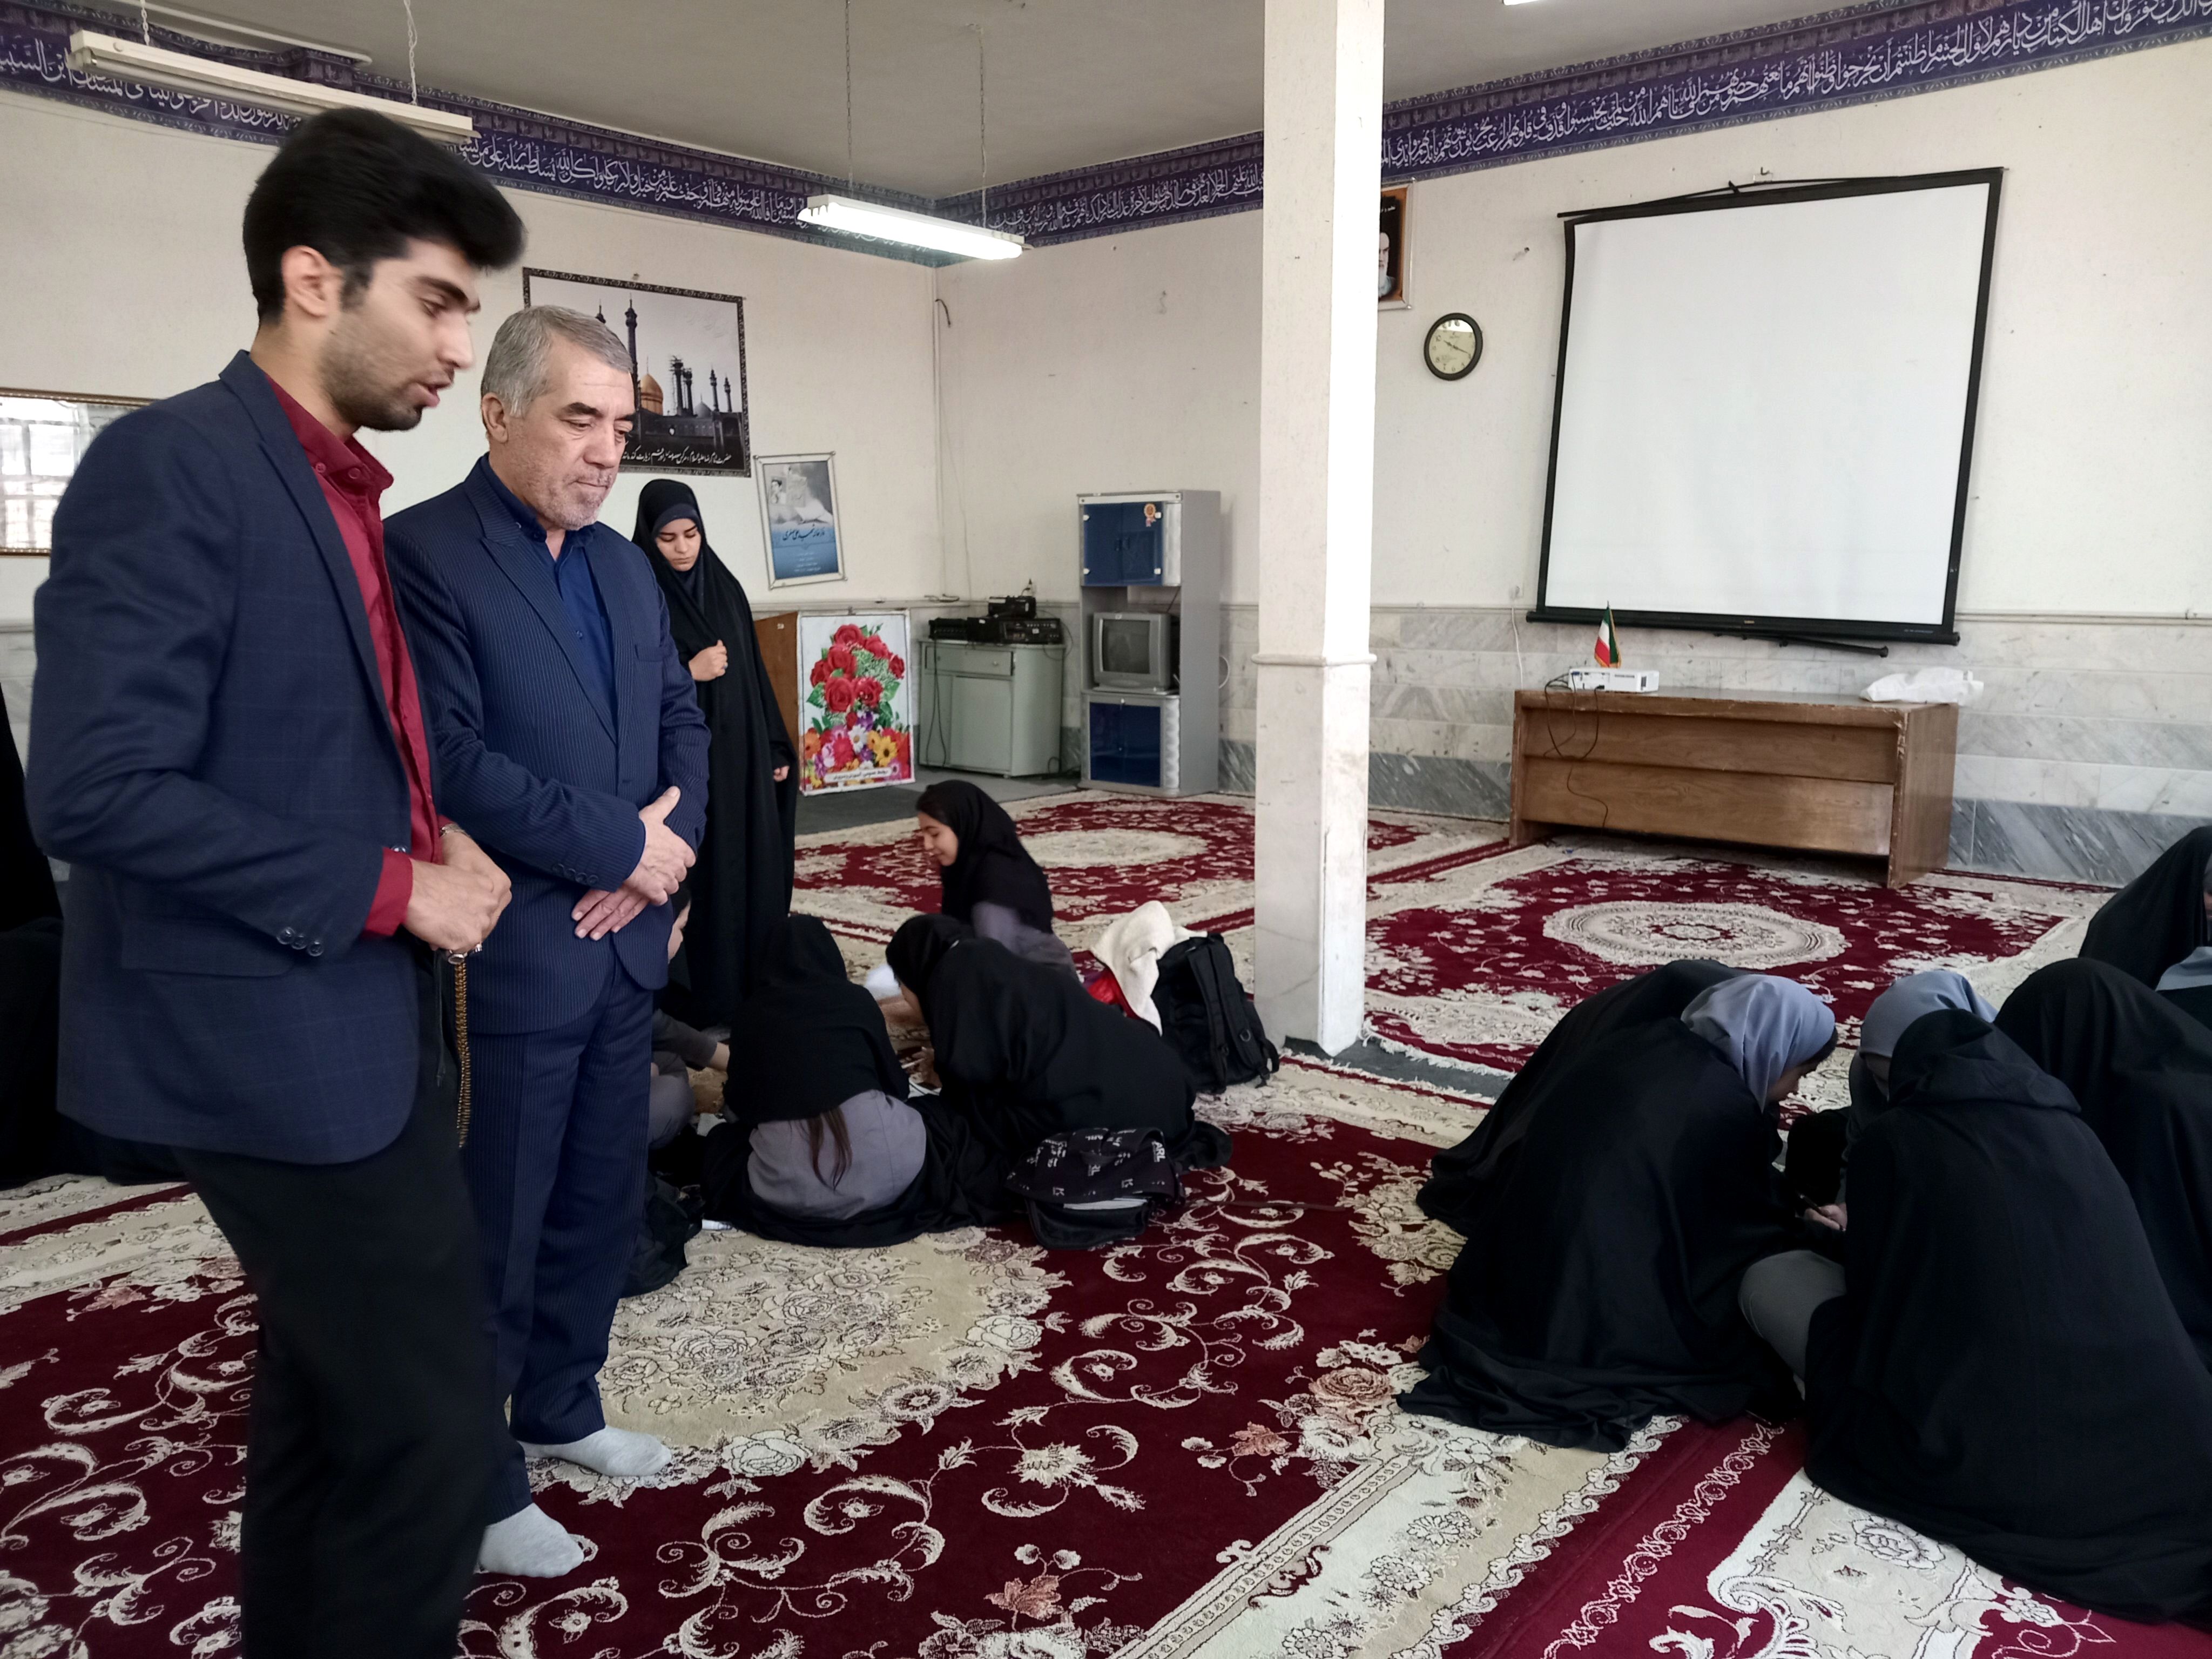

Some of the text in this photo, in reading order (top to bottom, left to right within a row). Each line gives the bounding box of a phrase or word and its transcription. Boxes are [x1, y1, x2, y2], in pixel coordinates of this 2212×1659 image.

[2114, 0, 2160, 35] فروا
[1622, 86, 1645, 112] من
[1629, 87, 1653, 126] الله
